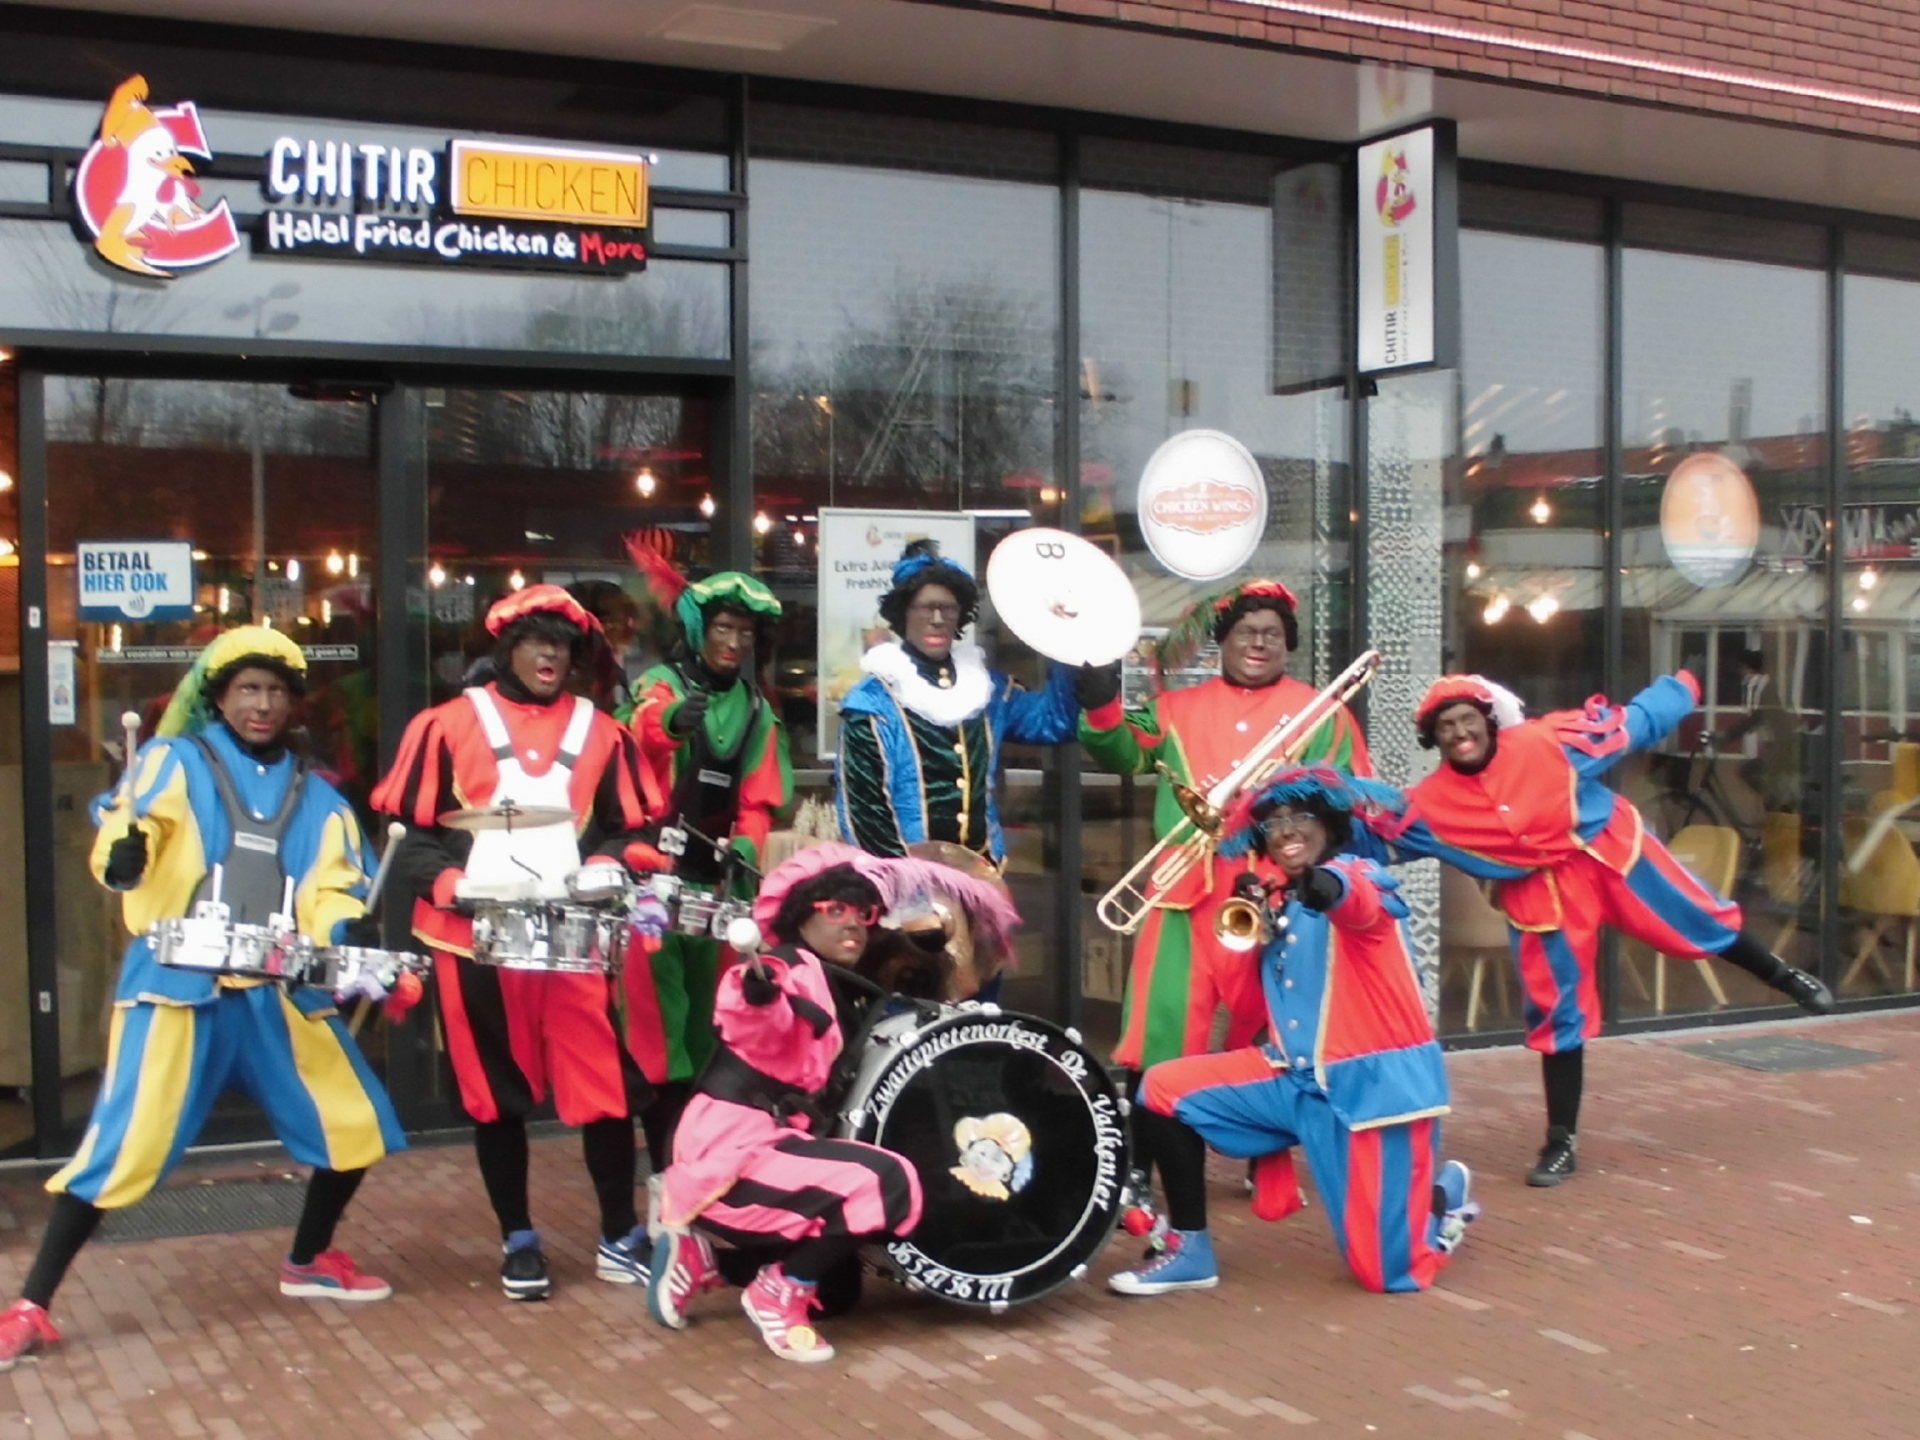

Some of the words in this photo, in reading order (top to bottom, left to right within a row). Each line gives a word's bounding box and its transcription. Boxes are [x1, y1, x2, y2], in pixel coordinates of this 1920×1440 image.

[271, 137, 436, 204] CHITIR
[467, 157, 638, 215] CHICKEN
[269, 211, 350, 249] Halal
[354, 213, 431, 253] Fried
[434, 223, 549, 257] Chicken
[553, 231, 577, 259] &
[580, 231, 646, 266] More
[1384, 310, 1398, 364] CHITIR
[84, 552, 152, 571] BETAAL
[84, 572, 126, 592] HIER
[131, 572, 168, 592] OOK
[1060, 1050, 1089, 1080] De
[977, 1277, 1014, 1300] 777
